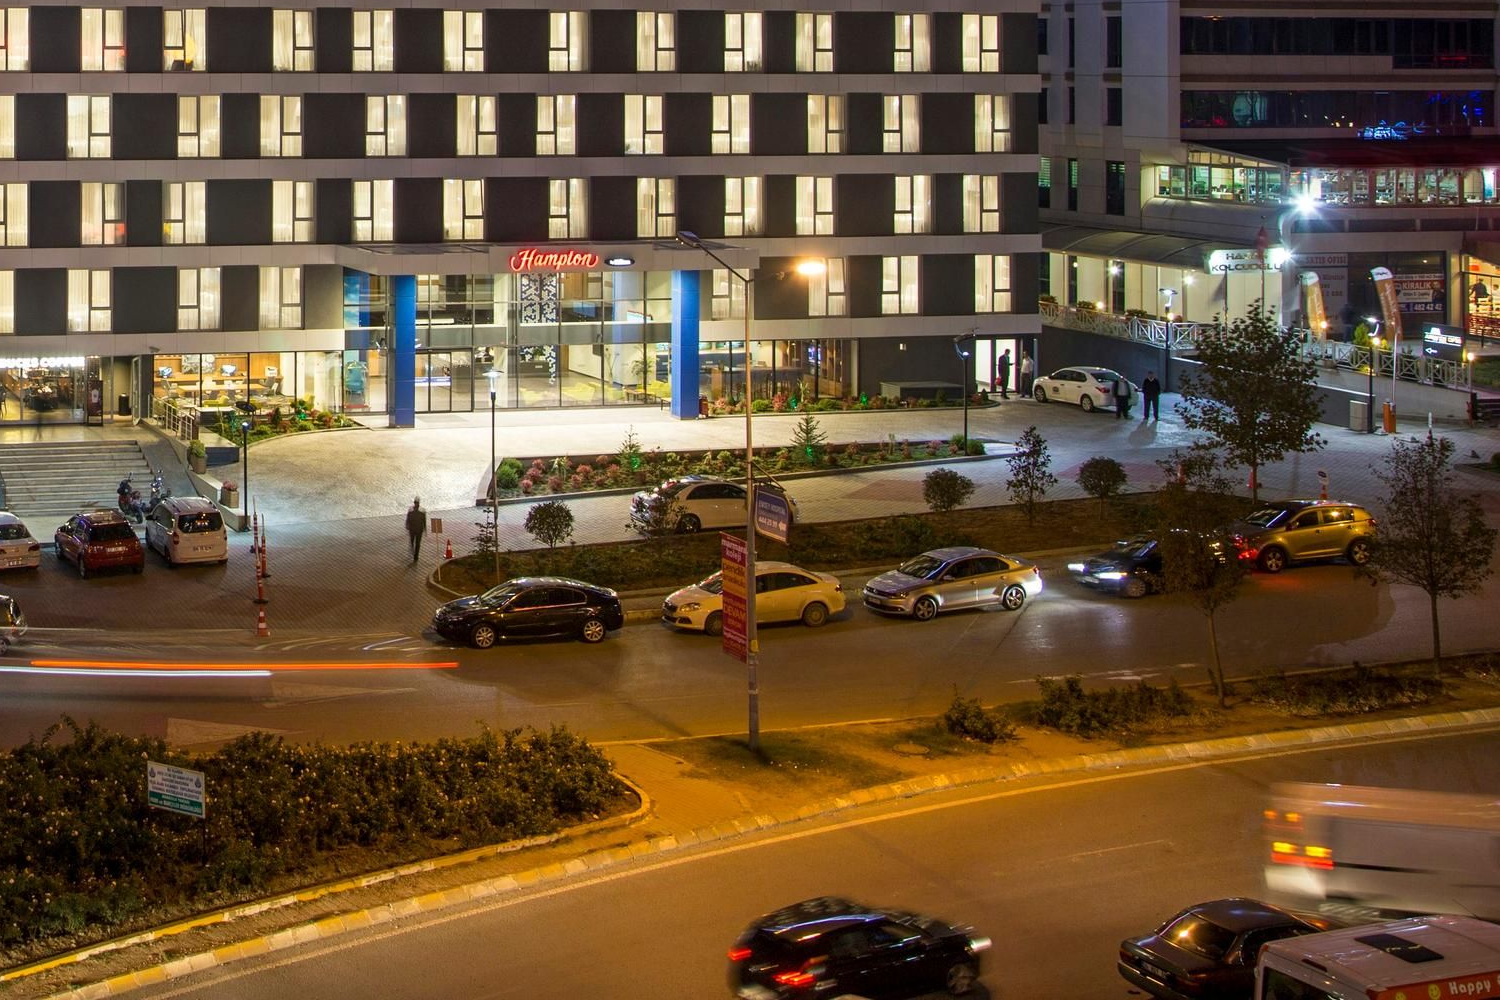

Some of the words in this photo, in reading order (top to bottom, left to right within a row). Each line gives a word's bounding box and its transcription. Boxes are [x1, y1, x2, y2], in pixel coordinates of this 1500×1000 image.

[510, 248, 599, 272] Hampton
[1402, 280, 1432, 290] KİRALIK
[1448, 979, 1492, 995] Happy
